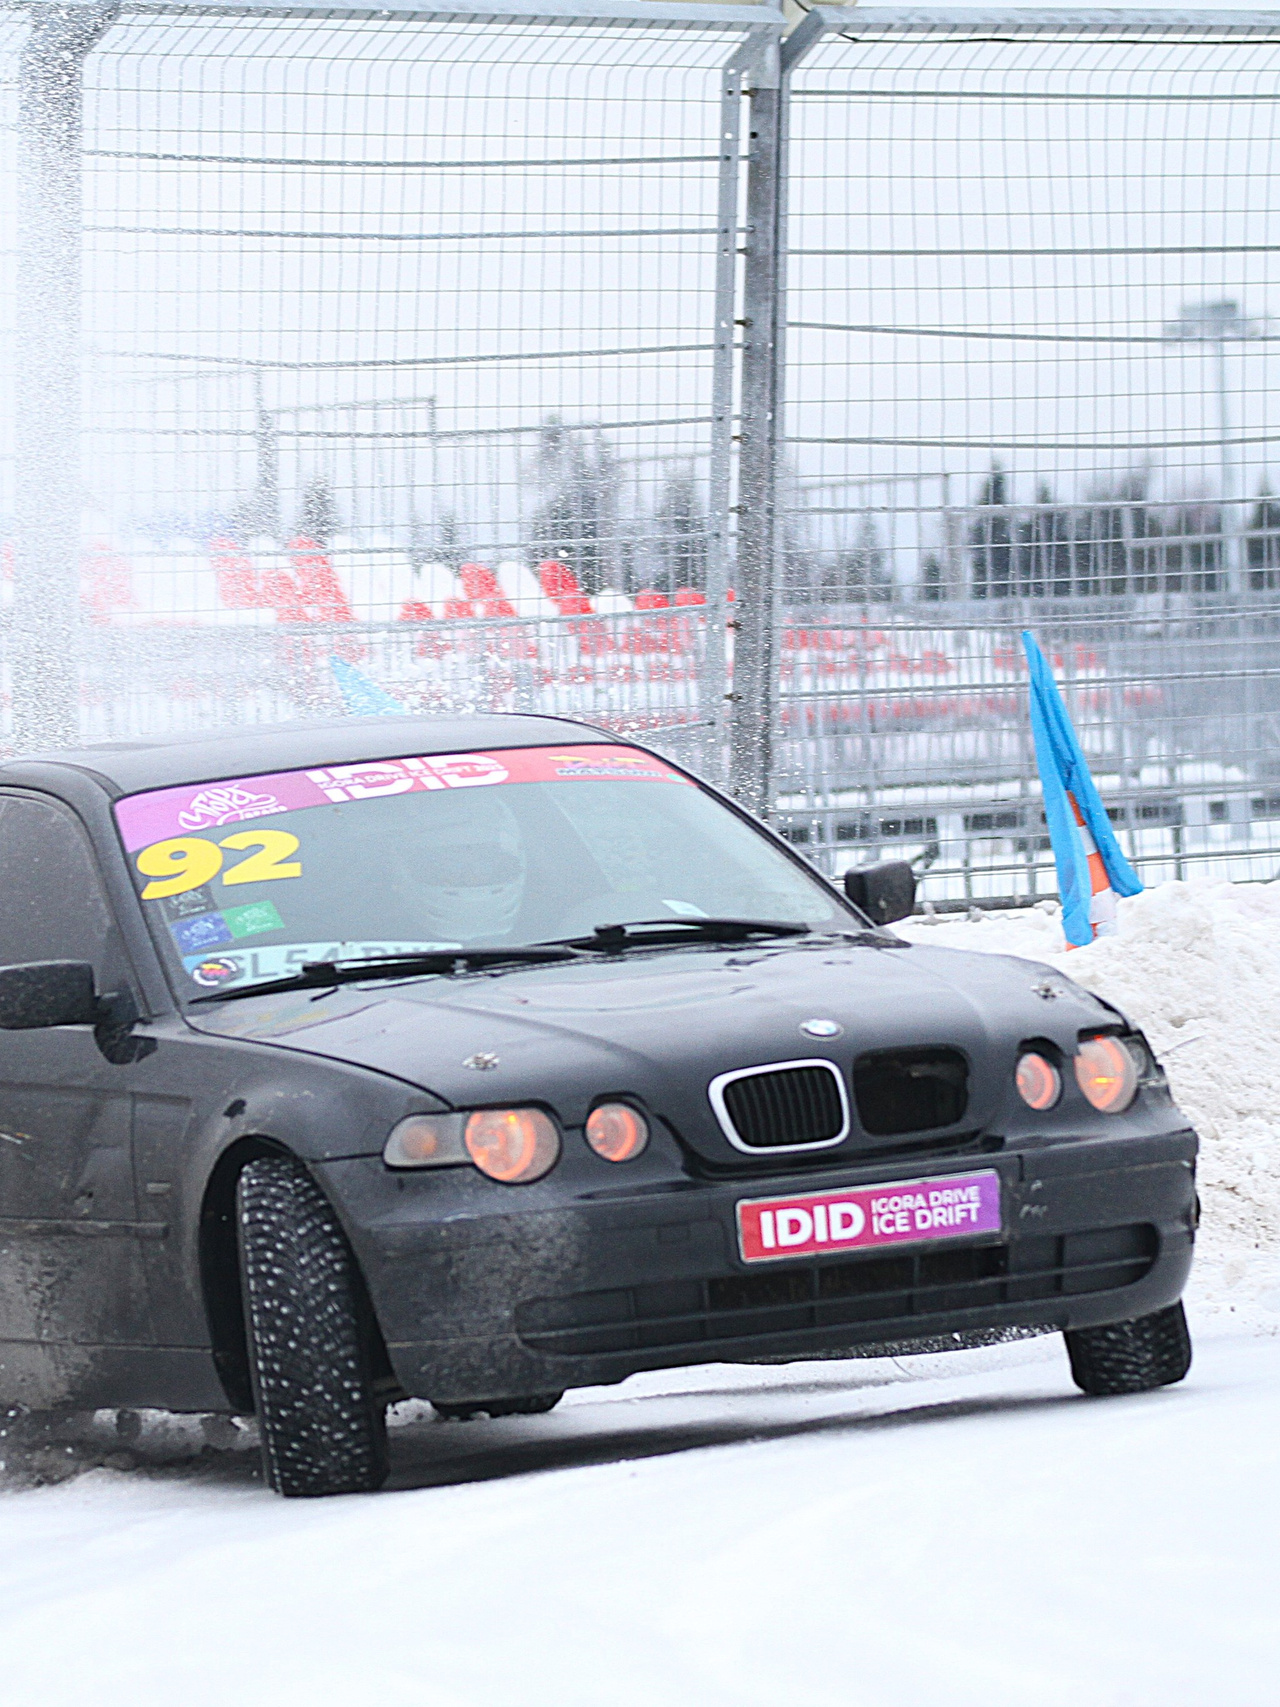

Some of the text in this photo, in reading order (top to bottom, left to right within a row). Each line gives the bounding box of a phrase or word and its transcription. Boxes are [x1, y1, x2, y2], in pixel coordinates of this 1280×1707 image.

[136, 830, 303, 900] 92
[871, 1185, 980, 1214] IGORA DRIVE
[872, 1202, 982, 1235] ICE DRIFT
[760, 1201, 866, 1248] IDID
